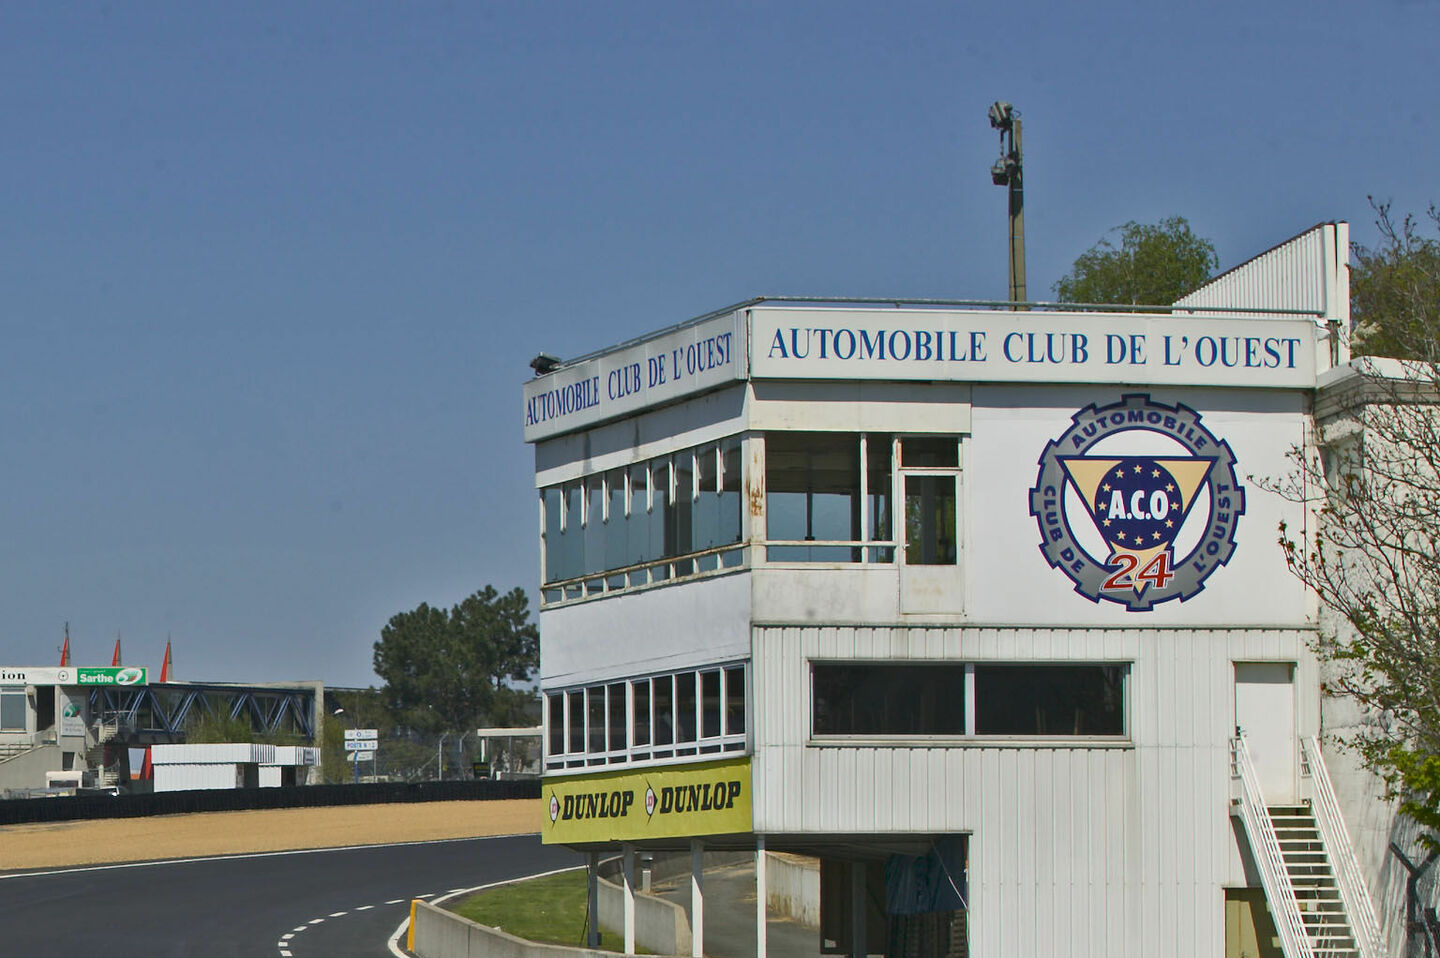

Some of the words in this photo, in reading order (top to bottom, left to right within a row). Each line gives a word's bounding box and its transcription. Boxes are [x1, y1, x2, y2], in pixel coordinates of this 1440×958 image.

[768, 328, 987, 362] AUTOMOBILE
[1003, 331, 1089, 364] CLUB
[1104, 333, 1148, 365] DE
[1162, 335, 1301, 369] L'OUEST
[525, 375, 600, 427] AUTOMOBILE
[607, 363, 641, 400] CLUB
[648, 354, 667, 388] DE
[673, 332, 732, 381] L'OUEST
[1070, 409, 1208, 450] AUTOMOBILE
[1043, 485, 1064, 543] CLUB
[1060, 546, 1086, 574] DE
[1100, 551, 1175, 592] 24
[79, 673, 114, 683] Sarthe
[561, 790, 634, 821] DUNLOP
[659, 780, 741, 814] DUNLOP
